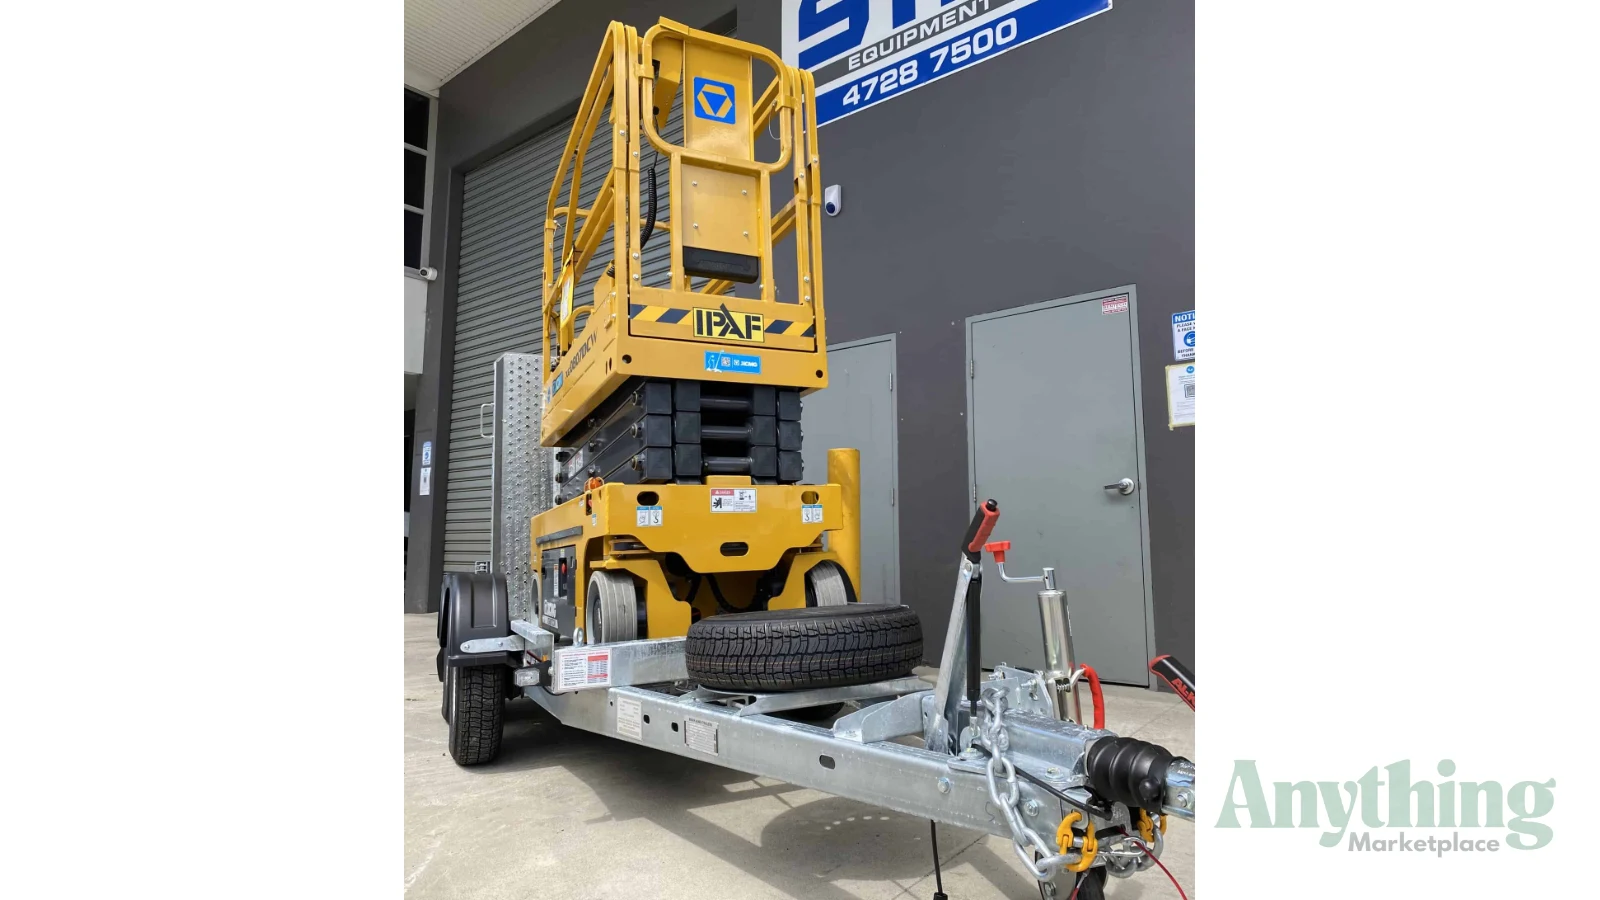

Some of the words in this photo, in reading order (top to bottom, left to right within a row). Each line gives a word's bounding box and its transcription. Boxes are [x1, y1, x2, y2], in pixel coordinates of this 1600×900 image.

[842, 59, 919, 106] 4728
[929, 17, 1018, 73] 7500
[848, 0, 992, 71] EQUIPMENT
[696, 303, 762, 340] IPAF
